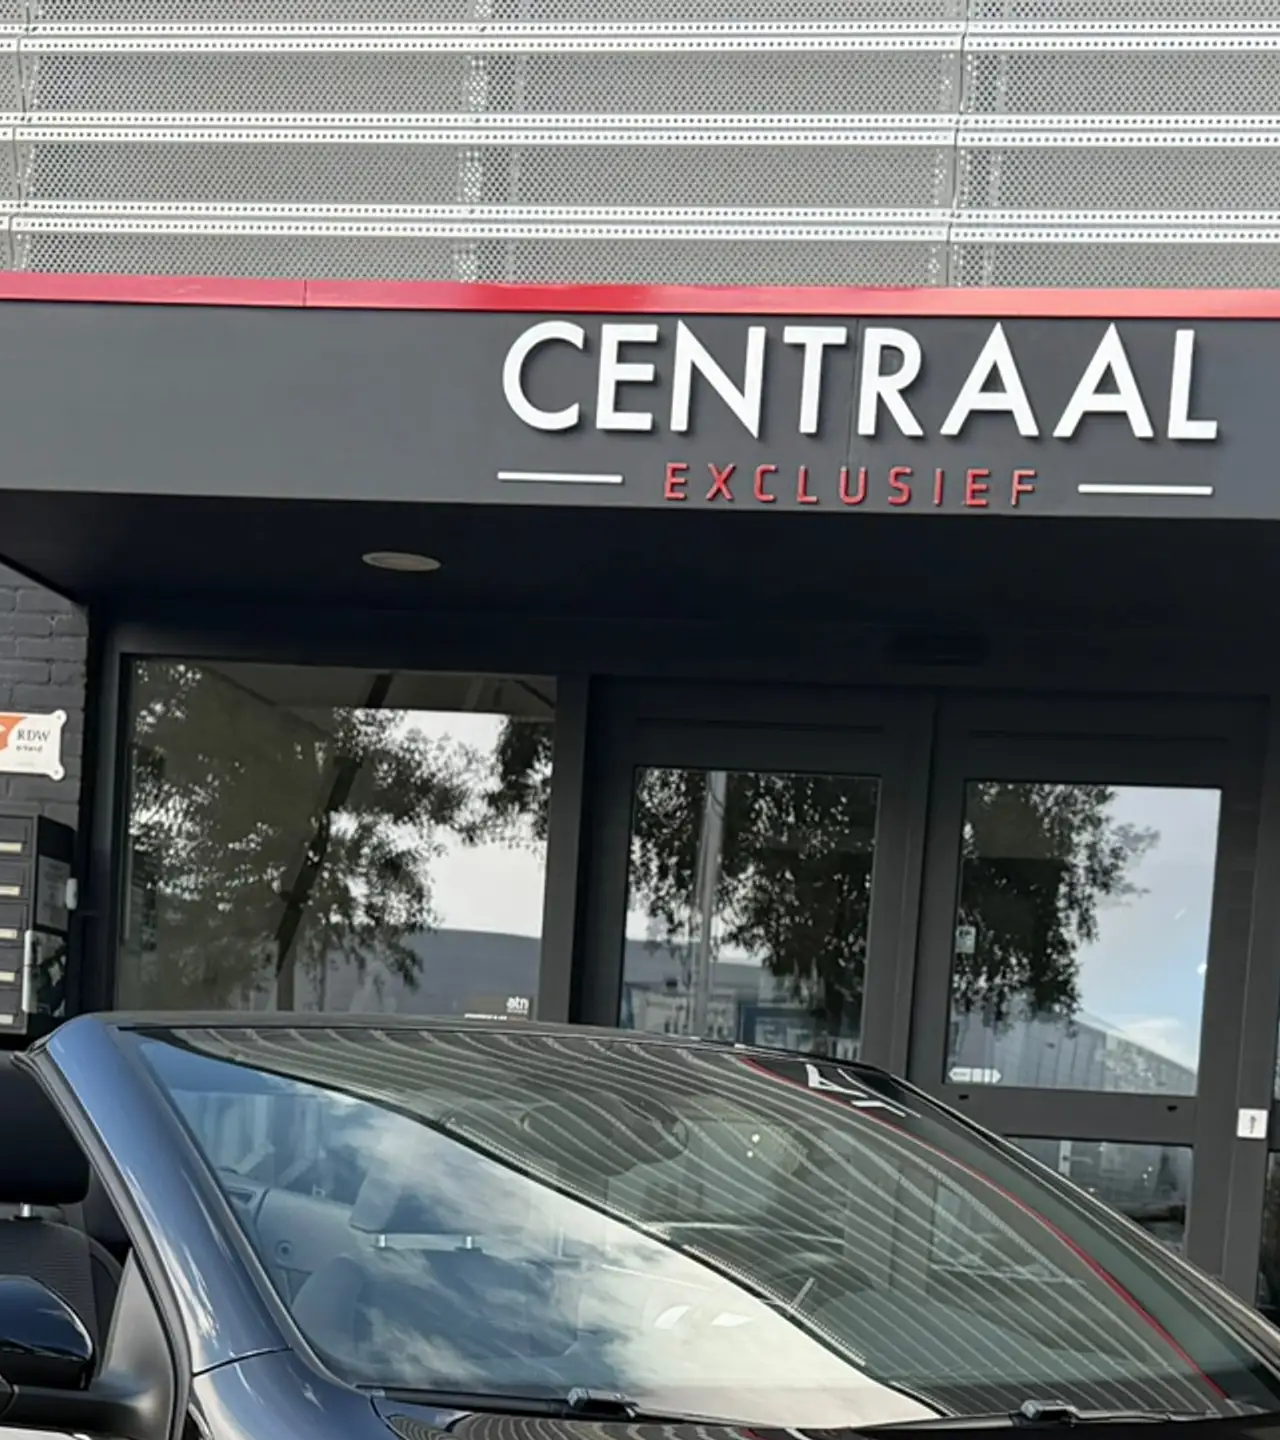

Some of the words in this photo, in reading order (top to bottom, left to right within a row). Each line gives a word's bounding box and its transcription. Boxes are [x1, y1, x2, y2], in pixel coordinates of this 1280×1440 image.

[502, 319, 1218, 440] CENTRAAL
[662, 462, 1038, 507] EXCLUSIEF
[17, 728, 51, 742] RDW
